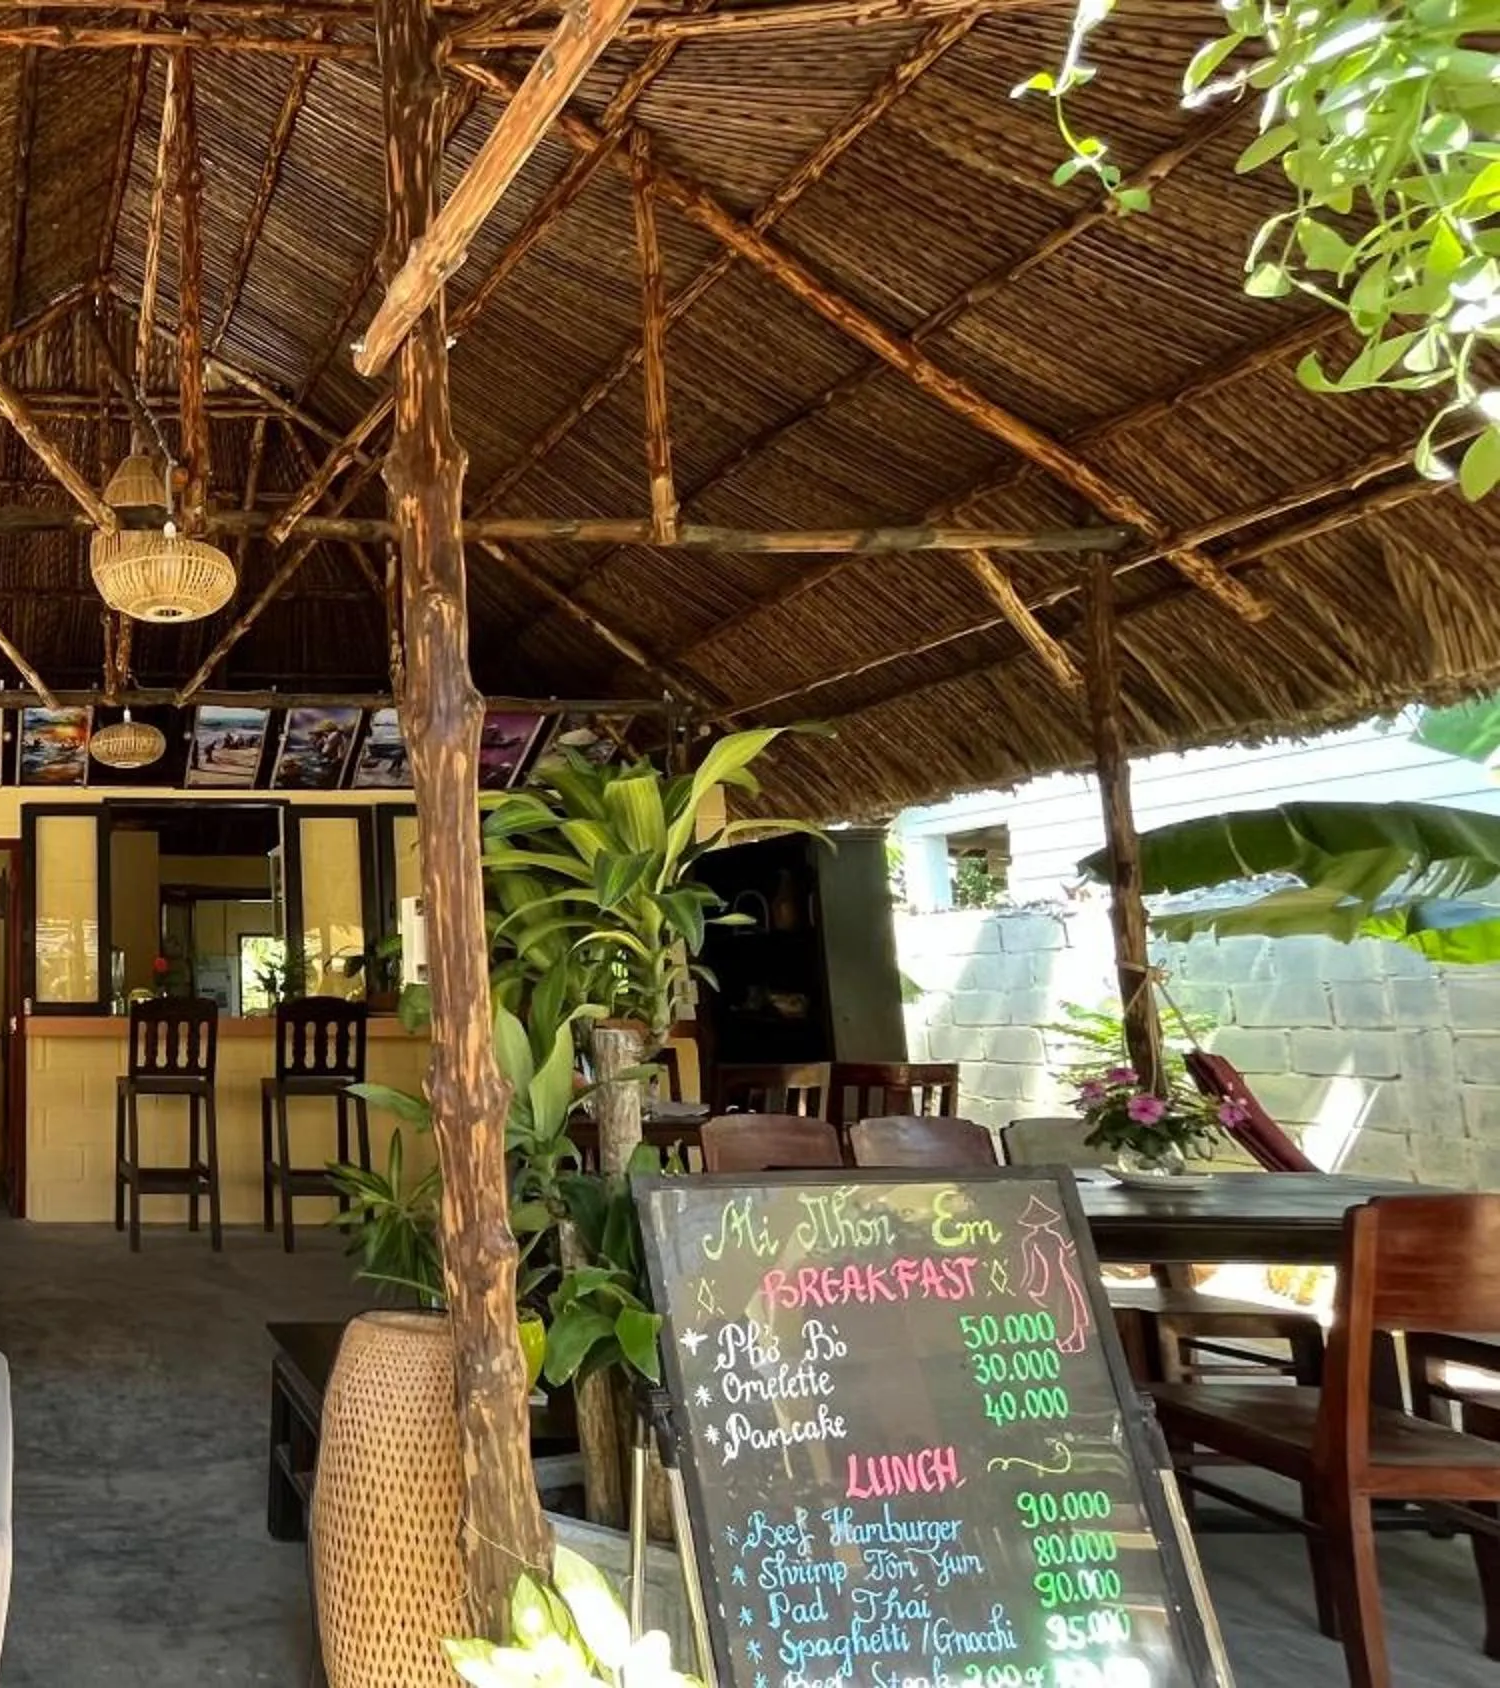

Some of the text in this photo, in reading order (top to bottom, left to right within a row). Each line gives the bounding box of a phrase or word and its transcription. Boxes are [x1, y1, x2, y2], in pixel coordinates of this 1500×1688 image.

[932, 1190, 1002, 1246] Em
[760, 1257, 977, 1310] BREAKFAST
[801, 1319, 847, 1362] Bò
[959, 1311, 1056, 1349] 50.000
[722, 1348, 1060, 1404] Omelette 30.000
[722, 1387, 1069, 1466] Pancake 40.000
[846, 1446, 959, 1499] LUNCH
[741, 1491, 1111, 1558] Beef Hamburger 90.000
[758, 1550, 847, 1595] Shrimp
[1033, 1531, 1117, 1566] 80.000
[768, 1569, 1121, 1628] Pad Thái 90.000
[778, 1618, 910, 1677] Spaghetti
